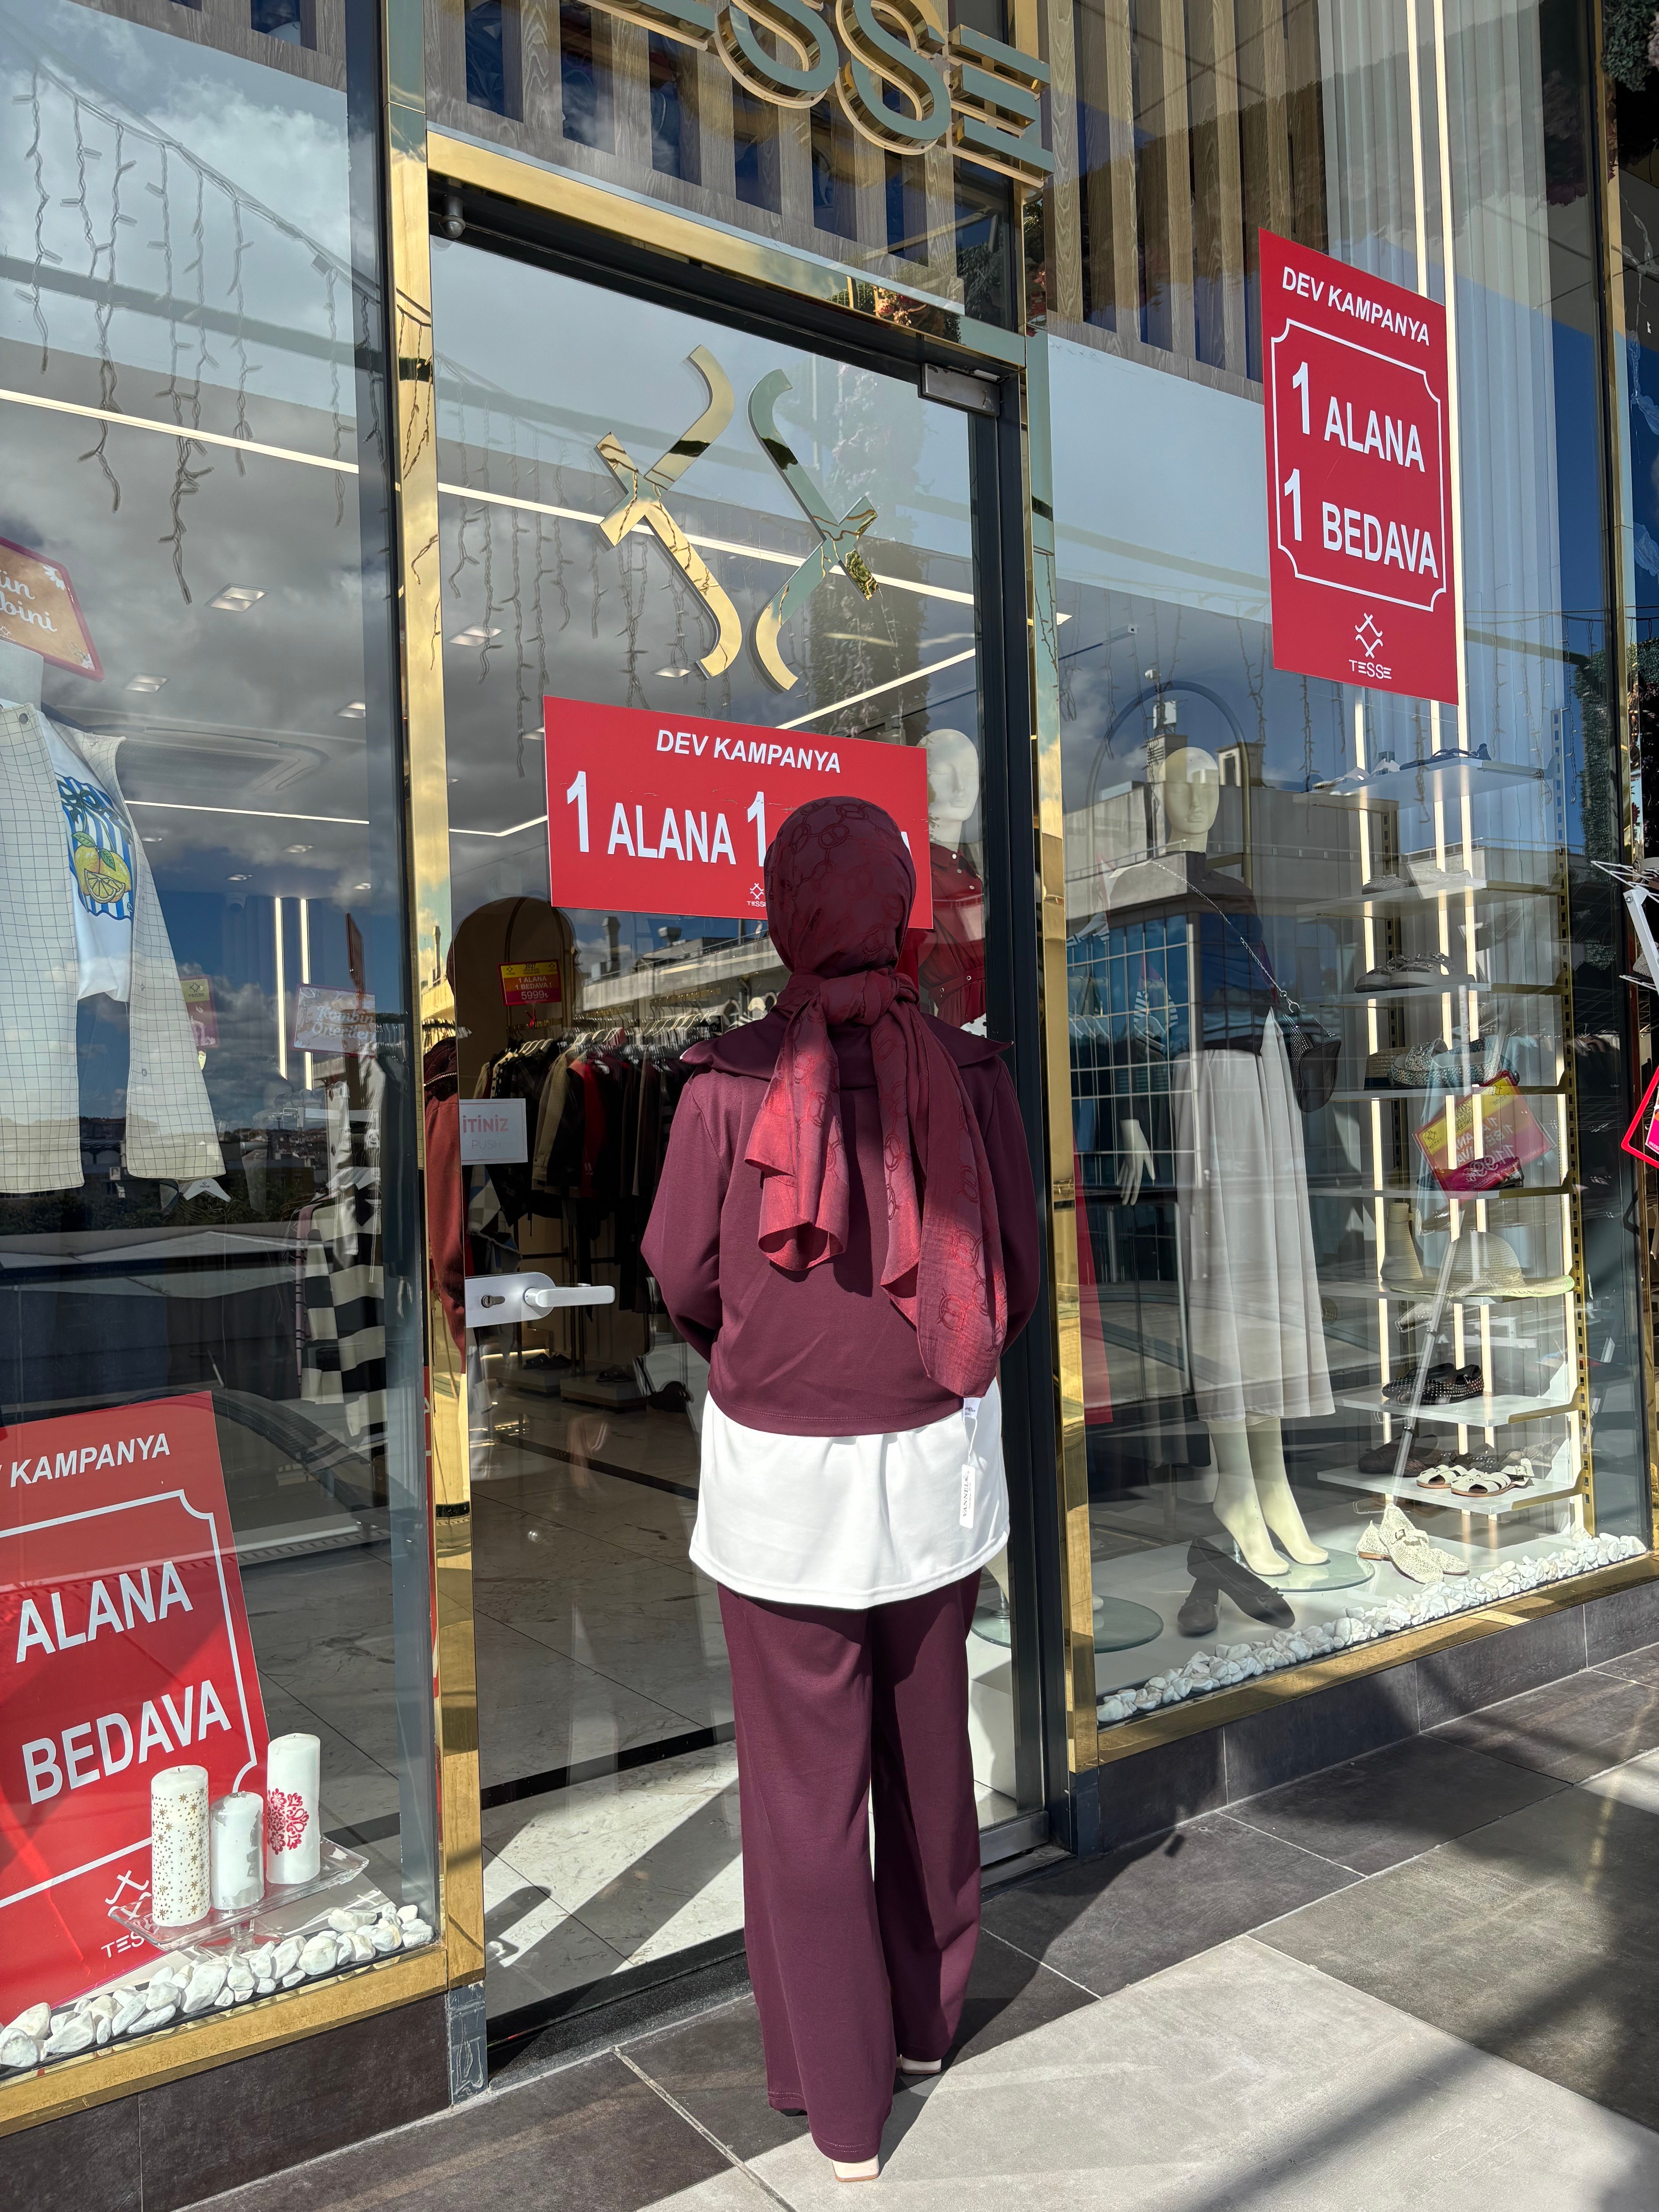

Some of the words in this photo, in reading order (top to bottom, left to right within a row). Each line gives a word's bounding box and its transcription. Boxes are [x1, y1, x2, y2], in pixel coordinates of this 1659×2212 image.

[1282, 266, 1324, 301] DEV
[1328, 285, 1429, 346] KAMPANYA
[1292, 361, 1310, 435] 1
[1324, 396, 1425, 472] ALANA
[1284, 468, 1302, 541] 1
[1322, 501, 1439, 579] BEDAVA
[1348, 659, 1392, 679] TESSE
[656, 730, 709, 756] DEV
[714, 737, 840, 773] KAMPANYA
[567, 771, 589, 853] 1
[607, 802, 737, 865] ALANA
[747, 791, 767, 867] 1
[463, 1115, 509, 1133] İTİNİZ
[472, 1139, 501, 1149] PUSH
[10, 1433, 170, 1488] KAMPANYA
[16, 1561, 194, 1663] ALANA
[22, 1680, 232, 1805] BEDAVA
